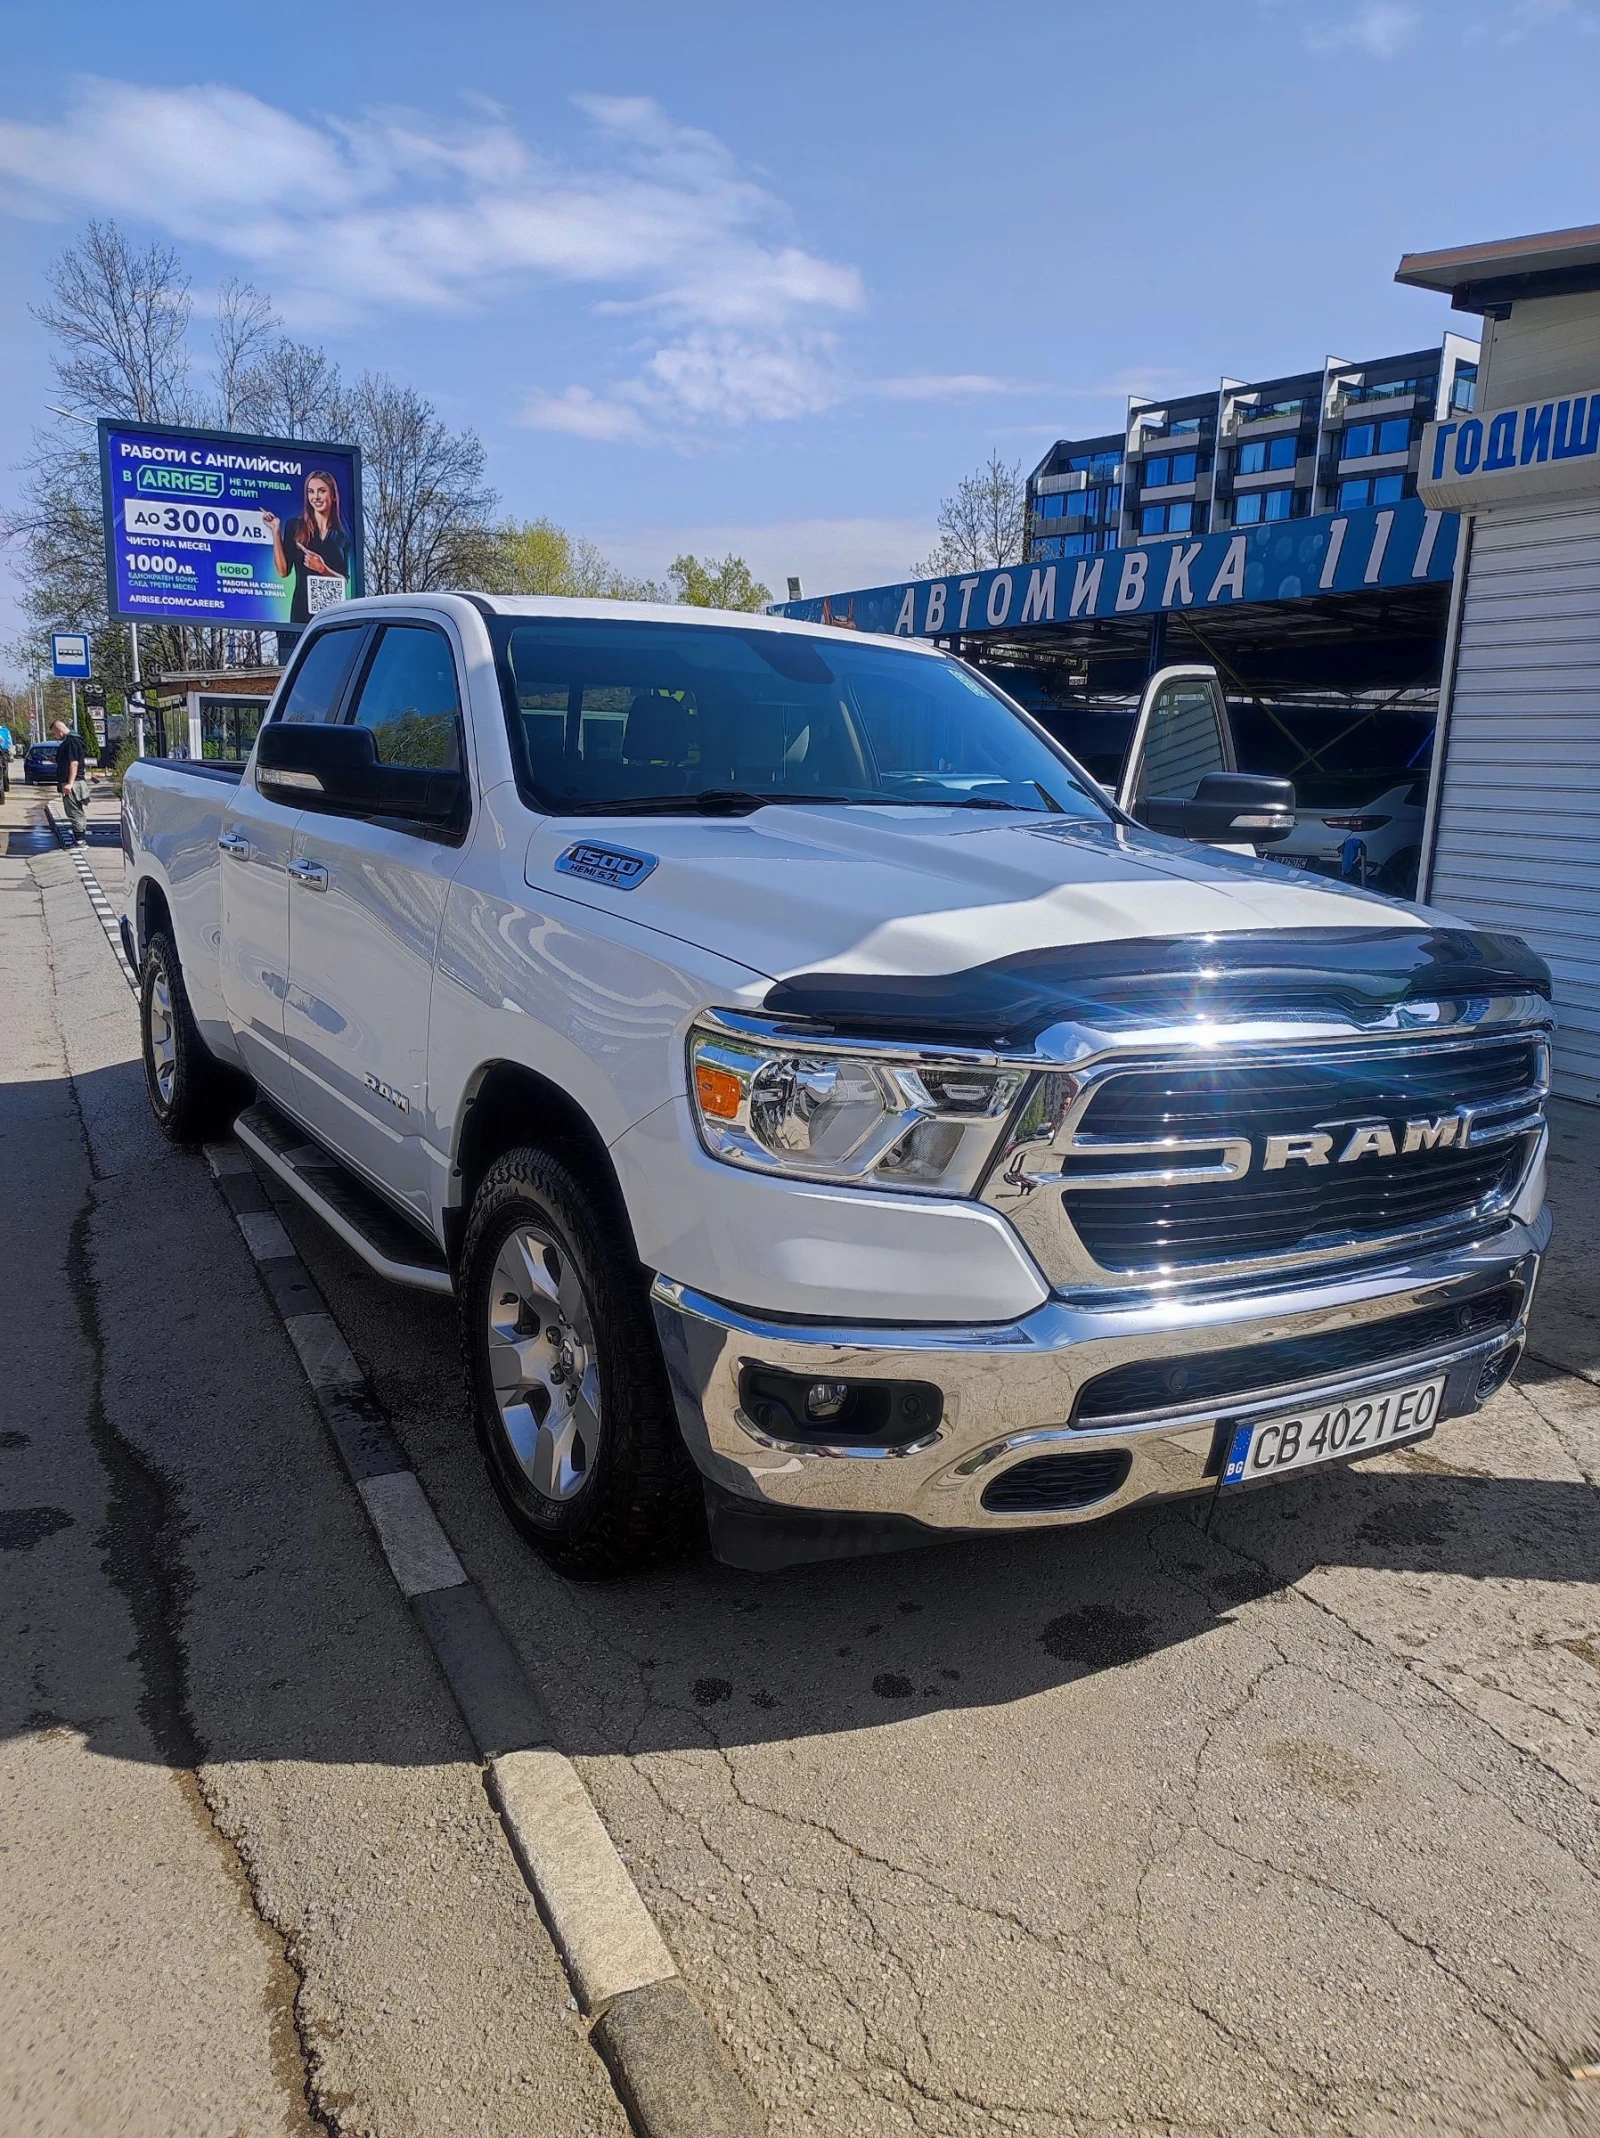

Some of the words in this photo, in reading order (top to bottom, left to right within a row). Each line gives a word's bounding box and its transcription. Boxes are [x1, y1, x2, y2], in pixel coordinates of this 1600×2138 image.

[121, 443, 187, 463] РАБОТИ
[190, 452, 202, 465] С
[205, 453, 302, 476] АНГЛИЙСКИ
[122, 470, 132, 482] В
[142, 470, 219, 493] ARRISE
[229, 478, 242, 487] НЕ
[244, 479, 256, 488] ТИ
[257, 480, 292, 492] ТРЯБВА
[134, 511, 160, 526] ДО
[163, 508, 240, 537] 3000
[242, 525, 267, 539] ЛВ.
[126, 536, 160, 547] ЧИСТО
[162, 540, 177, 549] НА
[178, 540, 212, 553] МЕСЕЦ
[128, 572, 174, 583] ЕДНОКРАТЕН
[175, 575, 200, 584] БОНУС
[219, 565, 249, 576] НОВО
[128, 580, 149, 589] СЛЕД
[149, 581, 171, 589] ТРЕТИ
[172, 583, 197, 593] МЕСЕЦ
[222, 579, 249, 588] РАБОТА
[249, 581, 260, 589] НА
[894, 535, 1248, 637] АВТОМИВКА
[129, 594, 226, 609] ARRISE.COM/CAREERS
[575, 847, 641, 875] 1500
[569, 863, 596, 877] HEMI
[598, 871, 622, 884] 5.7L
[364, 1071, 410, 1115] RAM
[1262, 1114, 1461, 1171] RAM
[1226, 1460, 1245, 1477] BG
